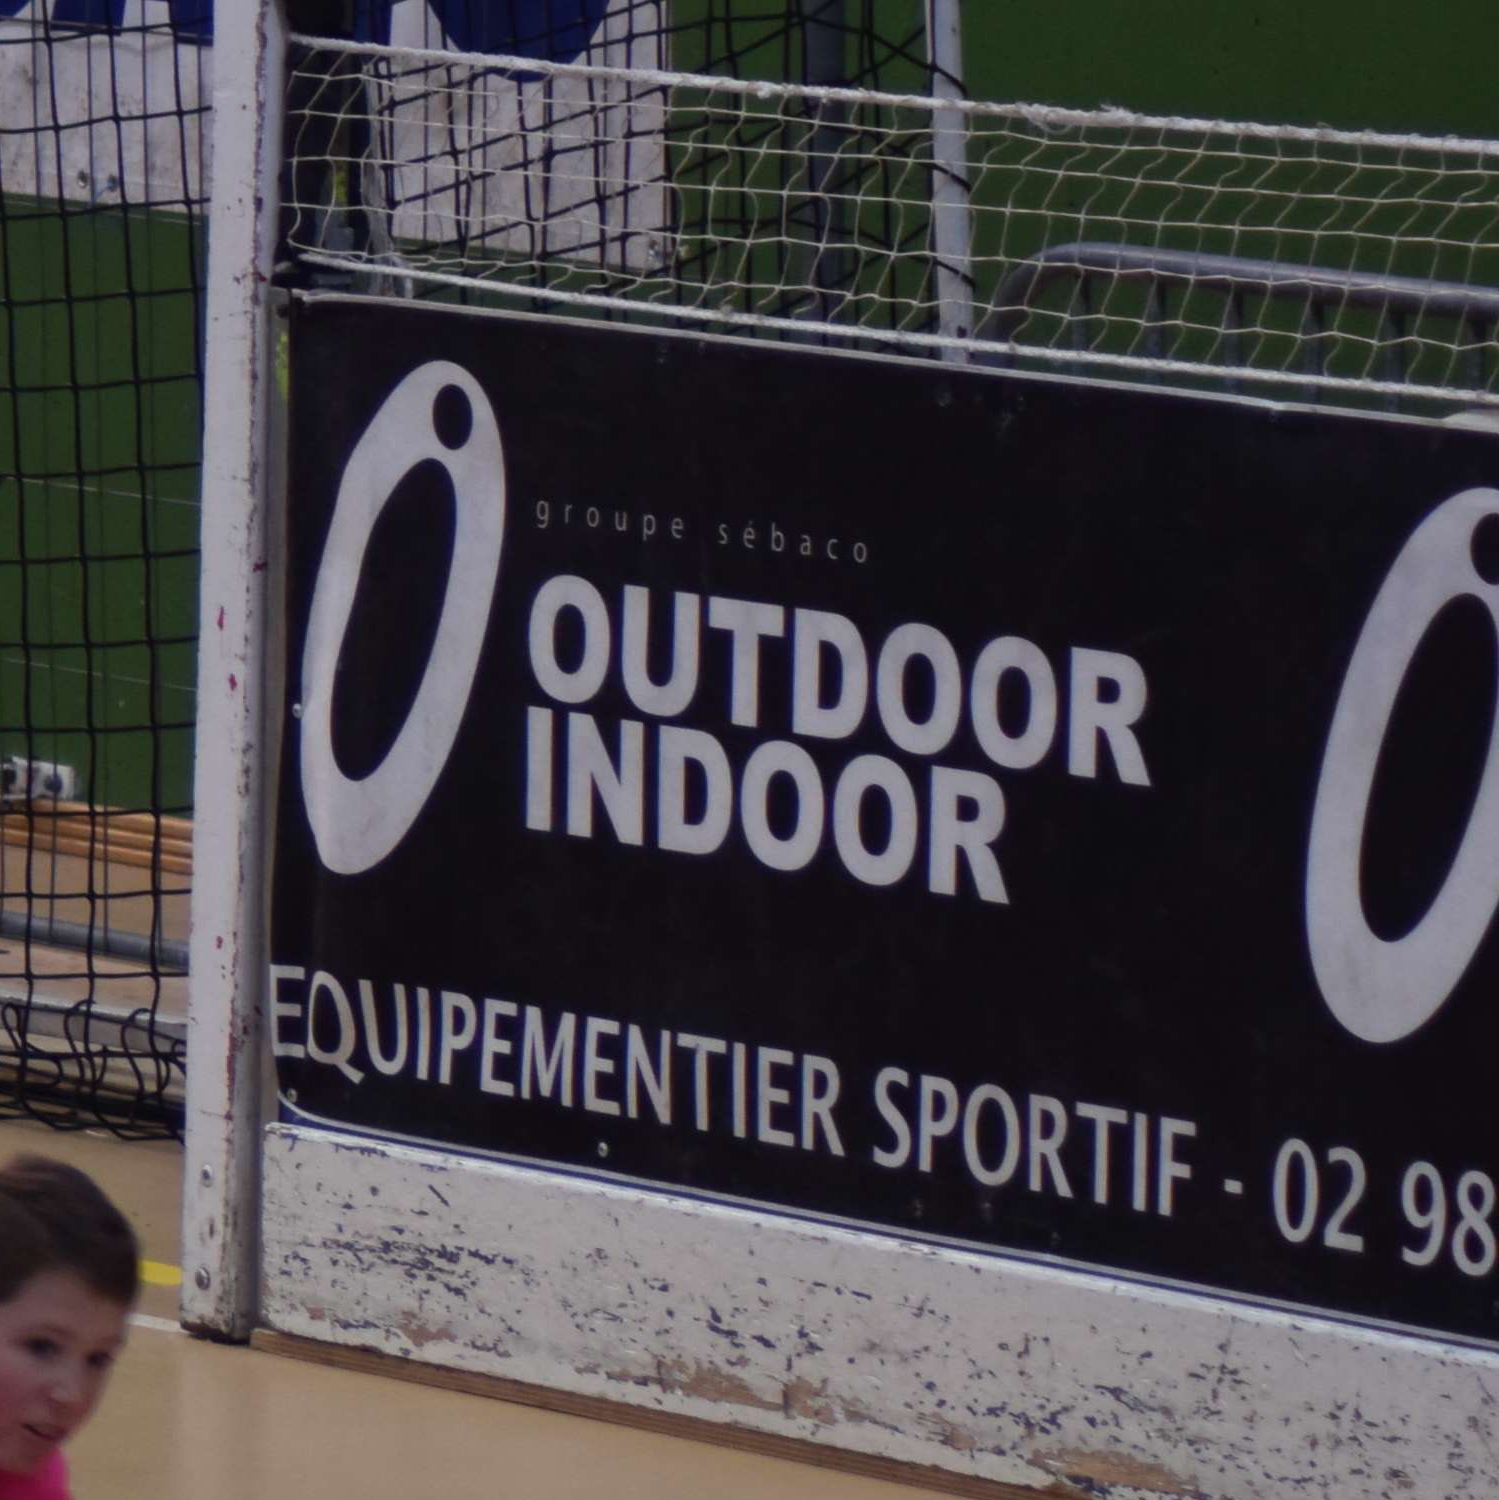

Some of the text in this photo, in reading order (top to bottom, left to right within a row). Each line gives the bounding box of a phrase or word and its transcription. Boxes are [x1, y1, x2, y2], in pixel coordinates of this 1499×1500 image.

[536, 500, 867, 563] groupe sébaco
[528, 574, 1152, 788] OUTDOOR
[526, 705, 1011, 906] INDOOR
[269, 963, 846, 1158] EQUIPEMENTIER
[873, 1066, 1197, 1218] SPORTIF
[1273, 1138, 1366, 1253] 02
[1401, 1161, 1497, 1277] 98
